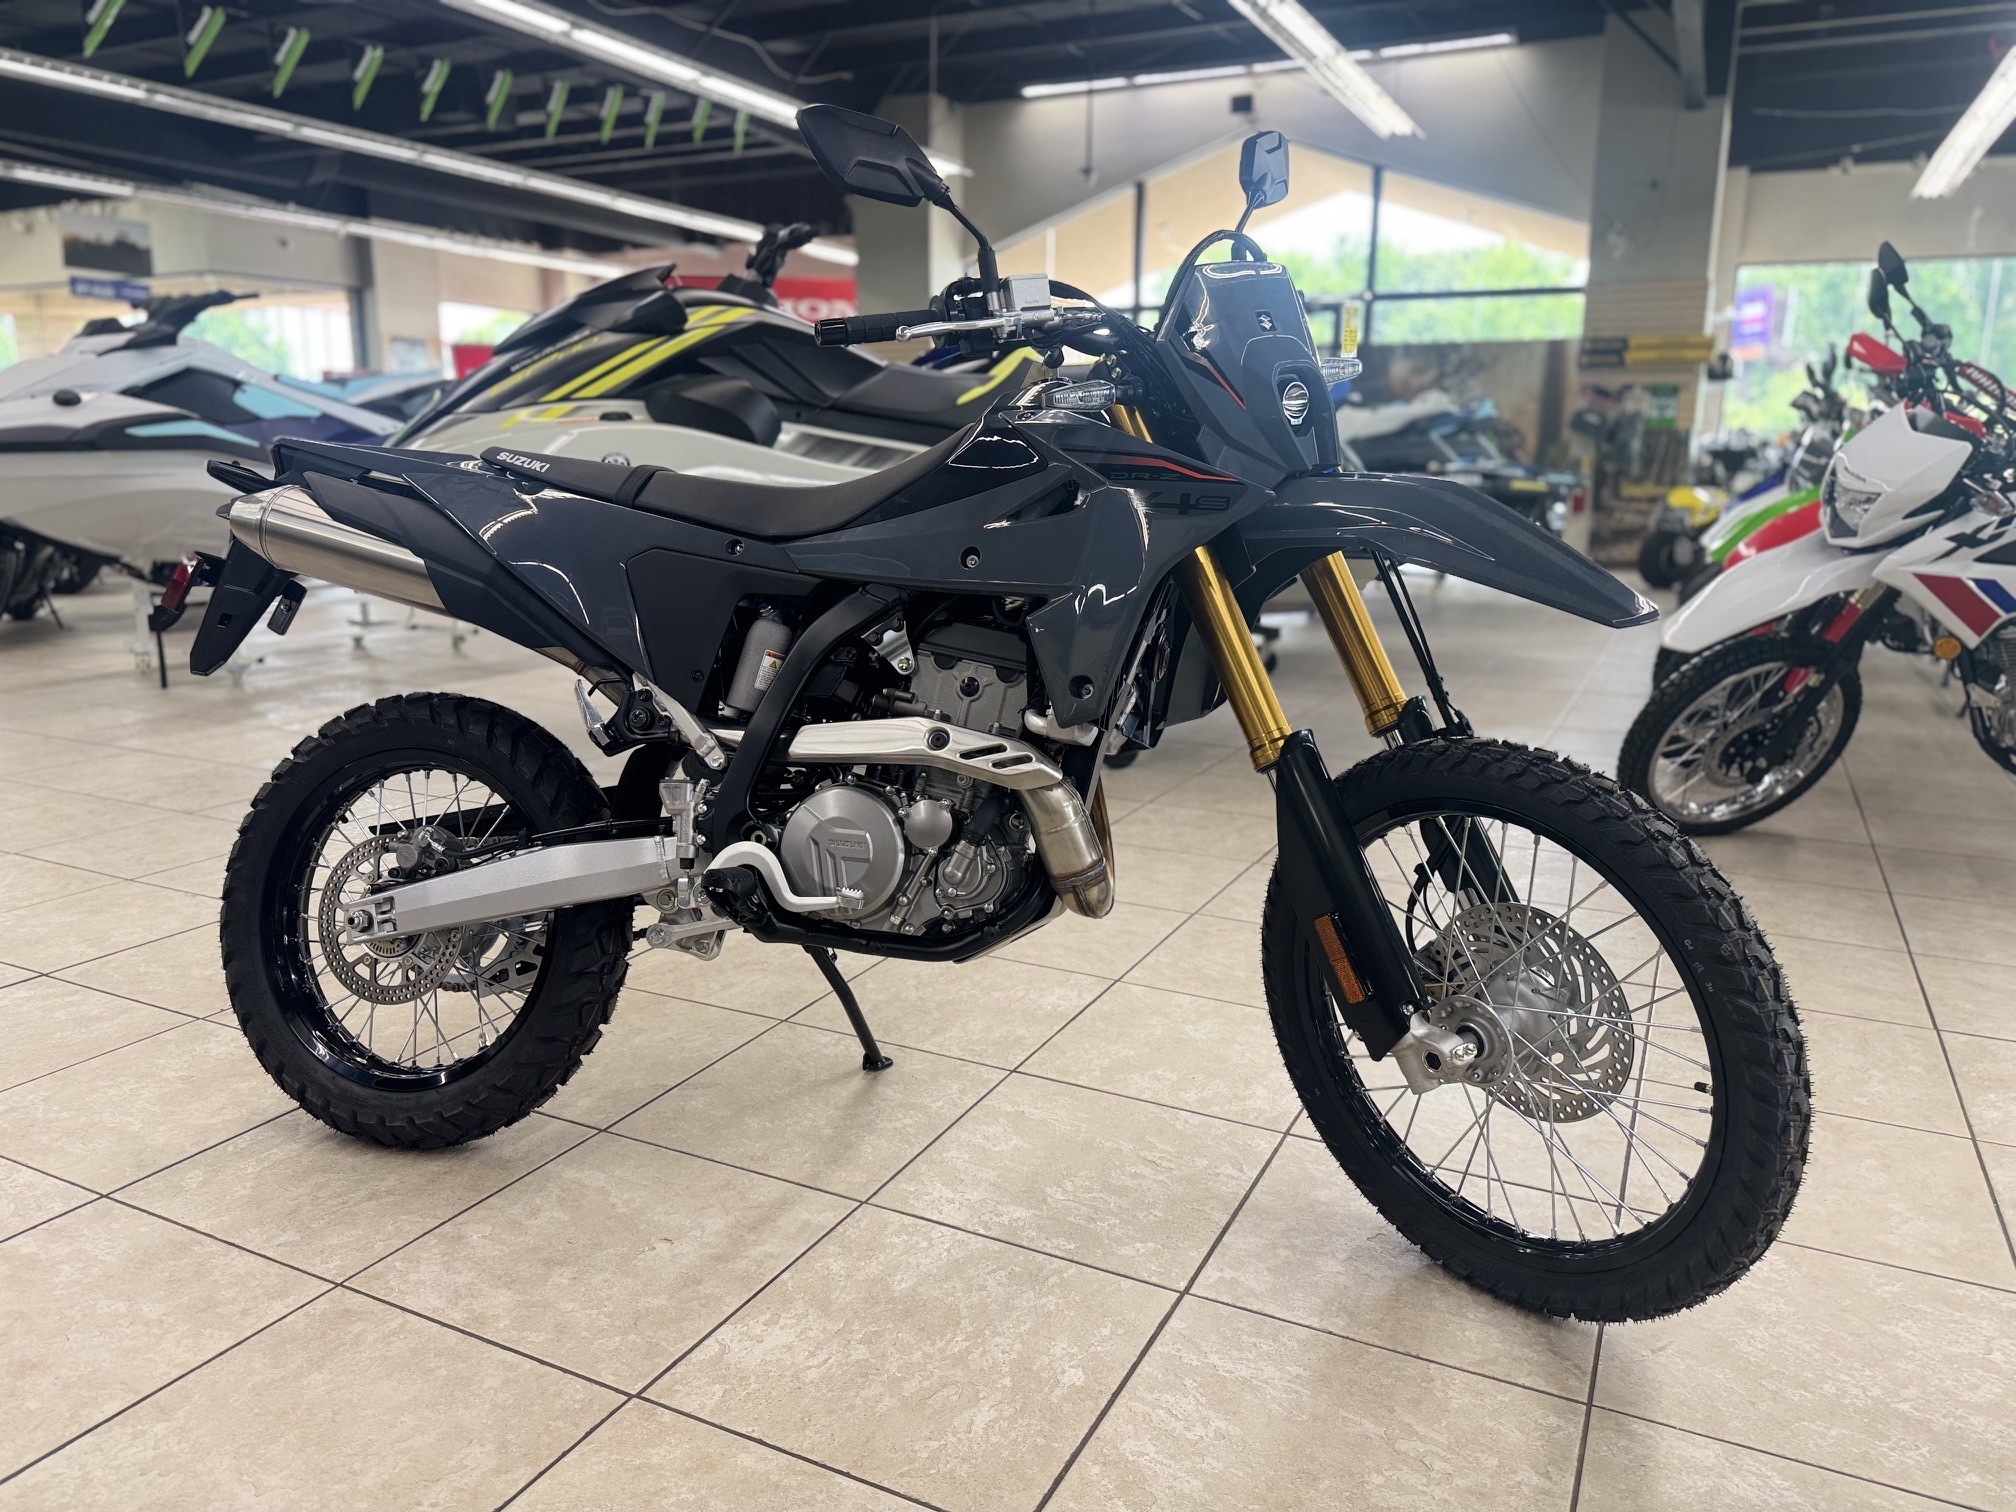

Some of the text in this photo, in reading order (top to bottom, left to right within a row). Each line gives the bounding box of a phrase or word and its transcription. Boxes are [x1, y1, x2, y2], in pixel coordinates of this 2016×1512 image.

[496, 451, 551, 473] SUZUKI
[1110, 472, 1181, 481] DR-Z
[827, 838, 867, 850] SUZUKI
